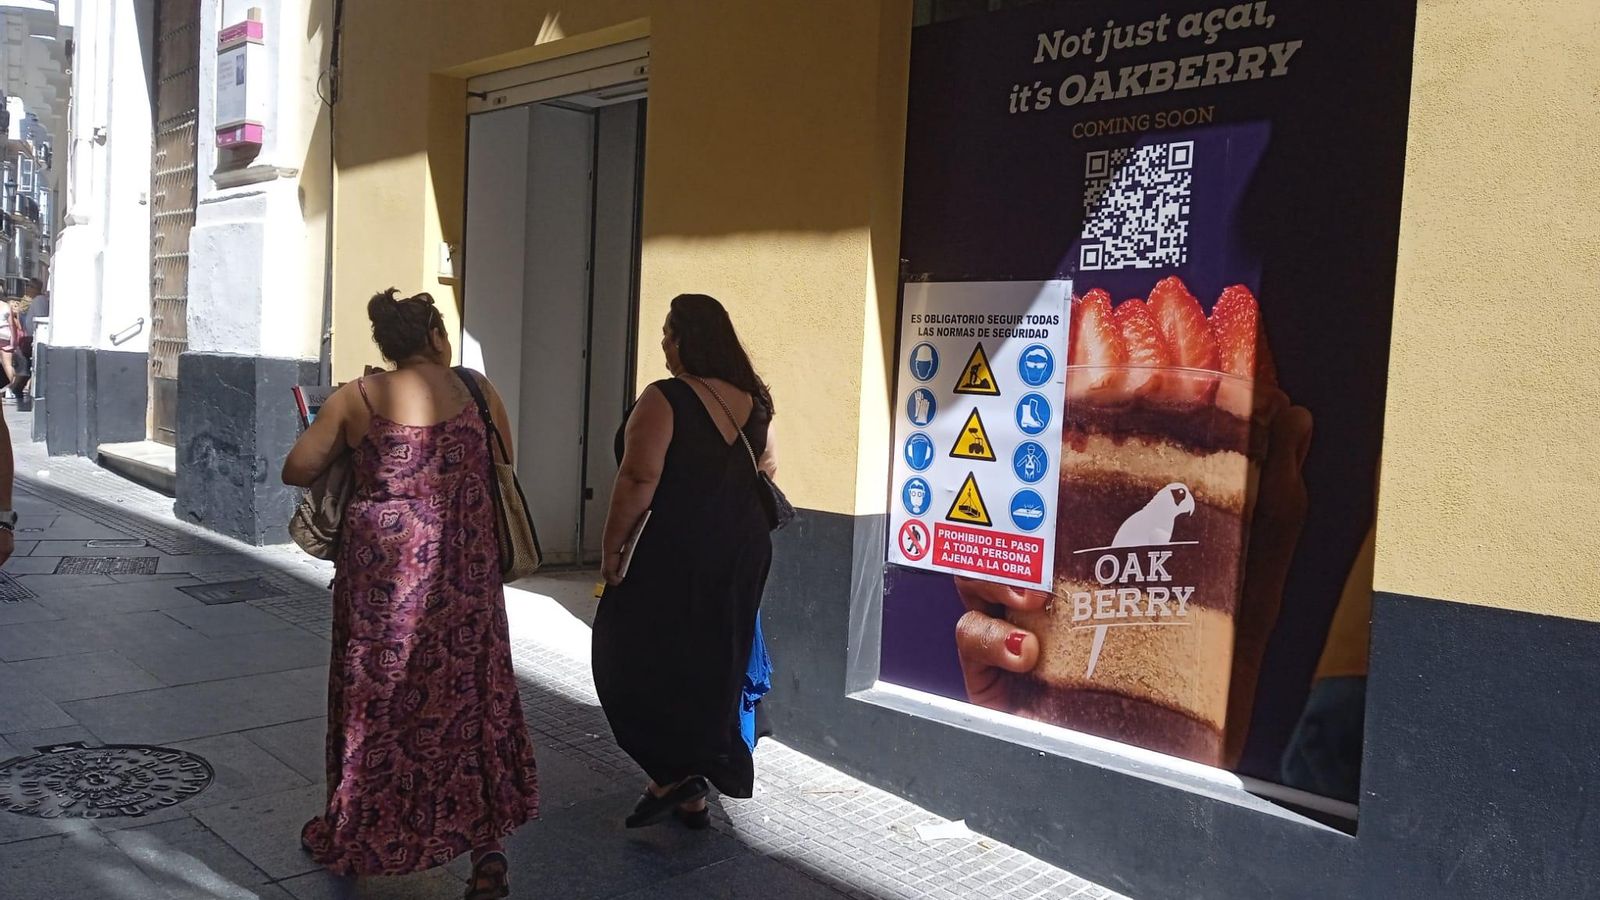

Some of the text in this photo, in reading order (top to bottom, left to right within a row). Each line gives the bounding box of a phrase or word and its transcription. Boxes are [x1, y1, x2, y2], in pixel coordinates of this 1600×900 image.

[1033, 25, 1096, 64] Not
[1096, 13, 1171, 63] just
[1008, 40, 1303, 114] it's OAKBERRY
[1072, 105, 1215, 139] COMING SOON
[911, 314, 1060, 326] ES OBLIGATORIO SEGUIR TODAS
[918, 327, 1049, 339] LAS NORMAS DE SEGURIDAD
[938, 529, 1039, 553] PROHIBIDO EL PASO
[943, 541, 1031, 564] A TODA PERSONA
[941, 552, 1031, 575] AJENA A LA OBRA
[1094, 550, 1173, 585] OAK
[1071, 586, 1195, 622] BERRY
